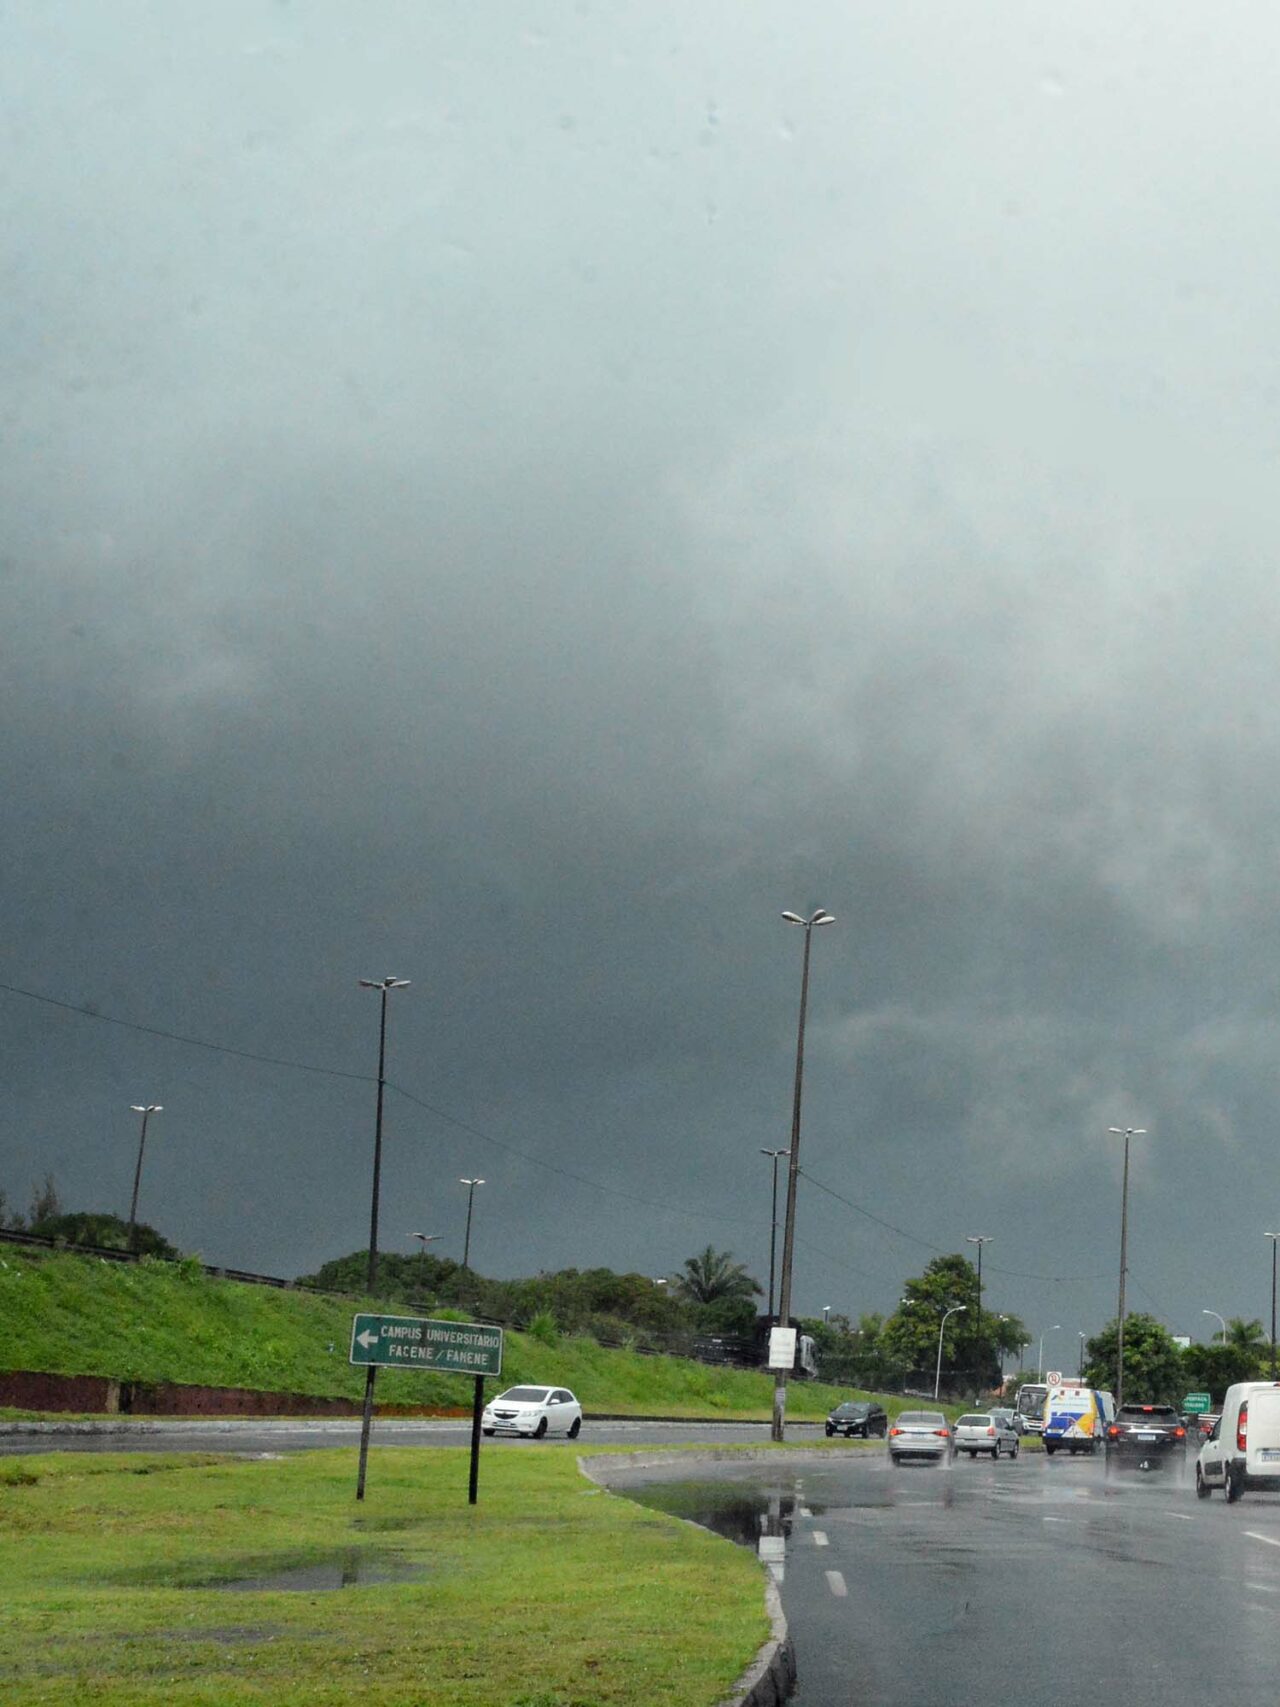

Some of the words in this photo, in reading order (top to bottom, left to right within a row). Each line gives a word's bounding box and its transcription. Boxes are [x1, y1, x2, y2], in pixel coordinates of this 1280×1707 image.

[381, 1326, 422, 1340] CAMPUS
[426, 1329, 500, 1348] UNIVERSITARIO
[389, 1345, 434, 1360] FACENE
